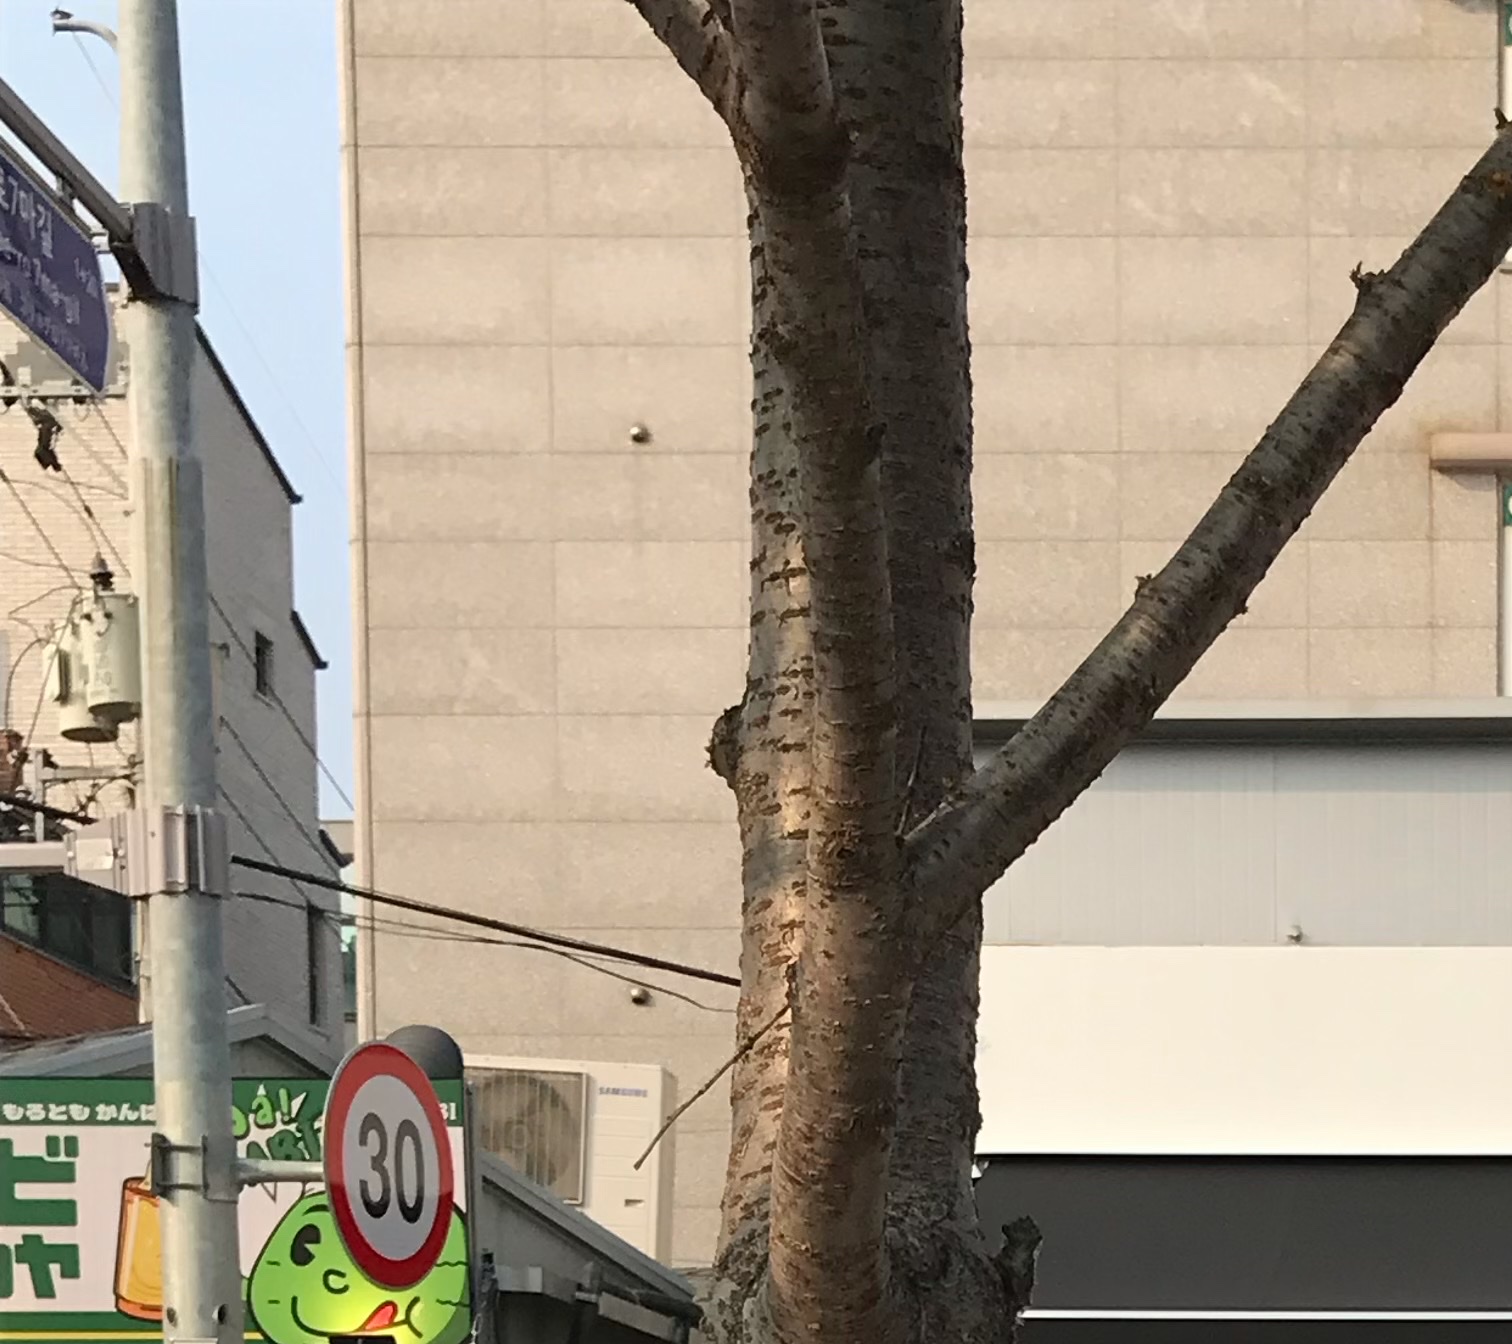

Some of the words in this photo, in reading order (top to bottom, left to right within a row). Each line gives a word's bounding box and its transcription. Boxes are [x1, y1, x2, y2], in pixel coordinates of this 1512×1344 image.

[2, 1103, 90, 1121] もろとも
[358, 1111, 425, 1224] 30
